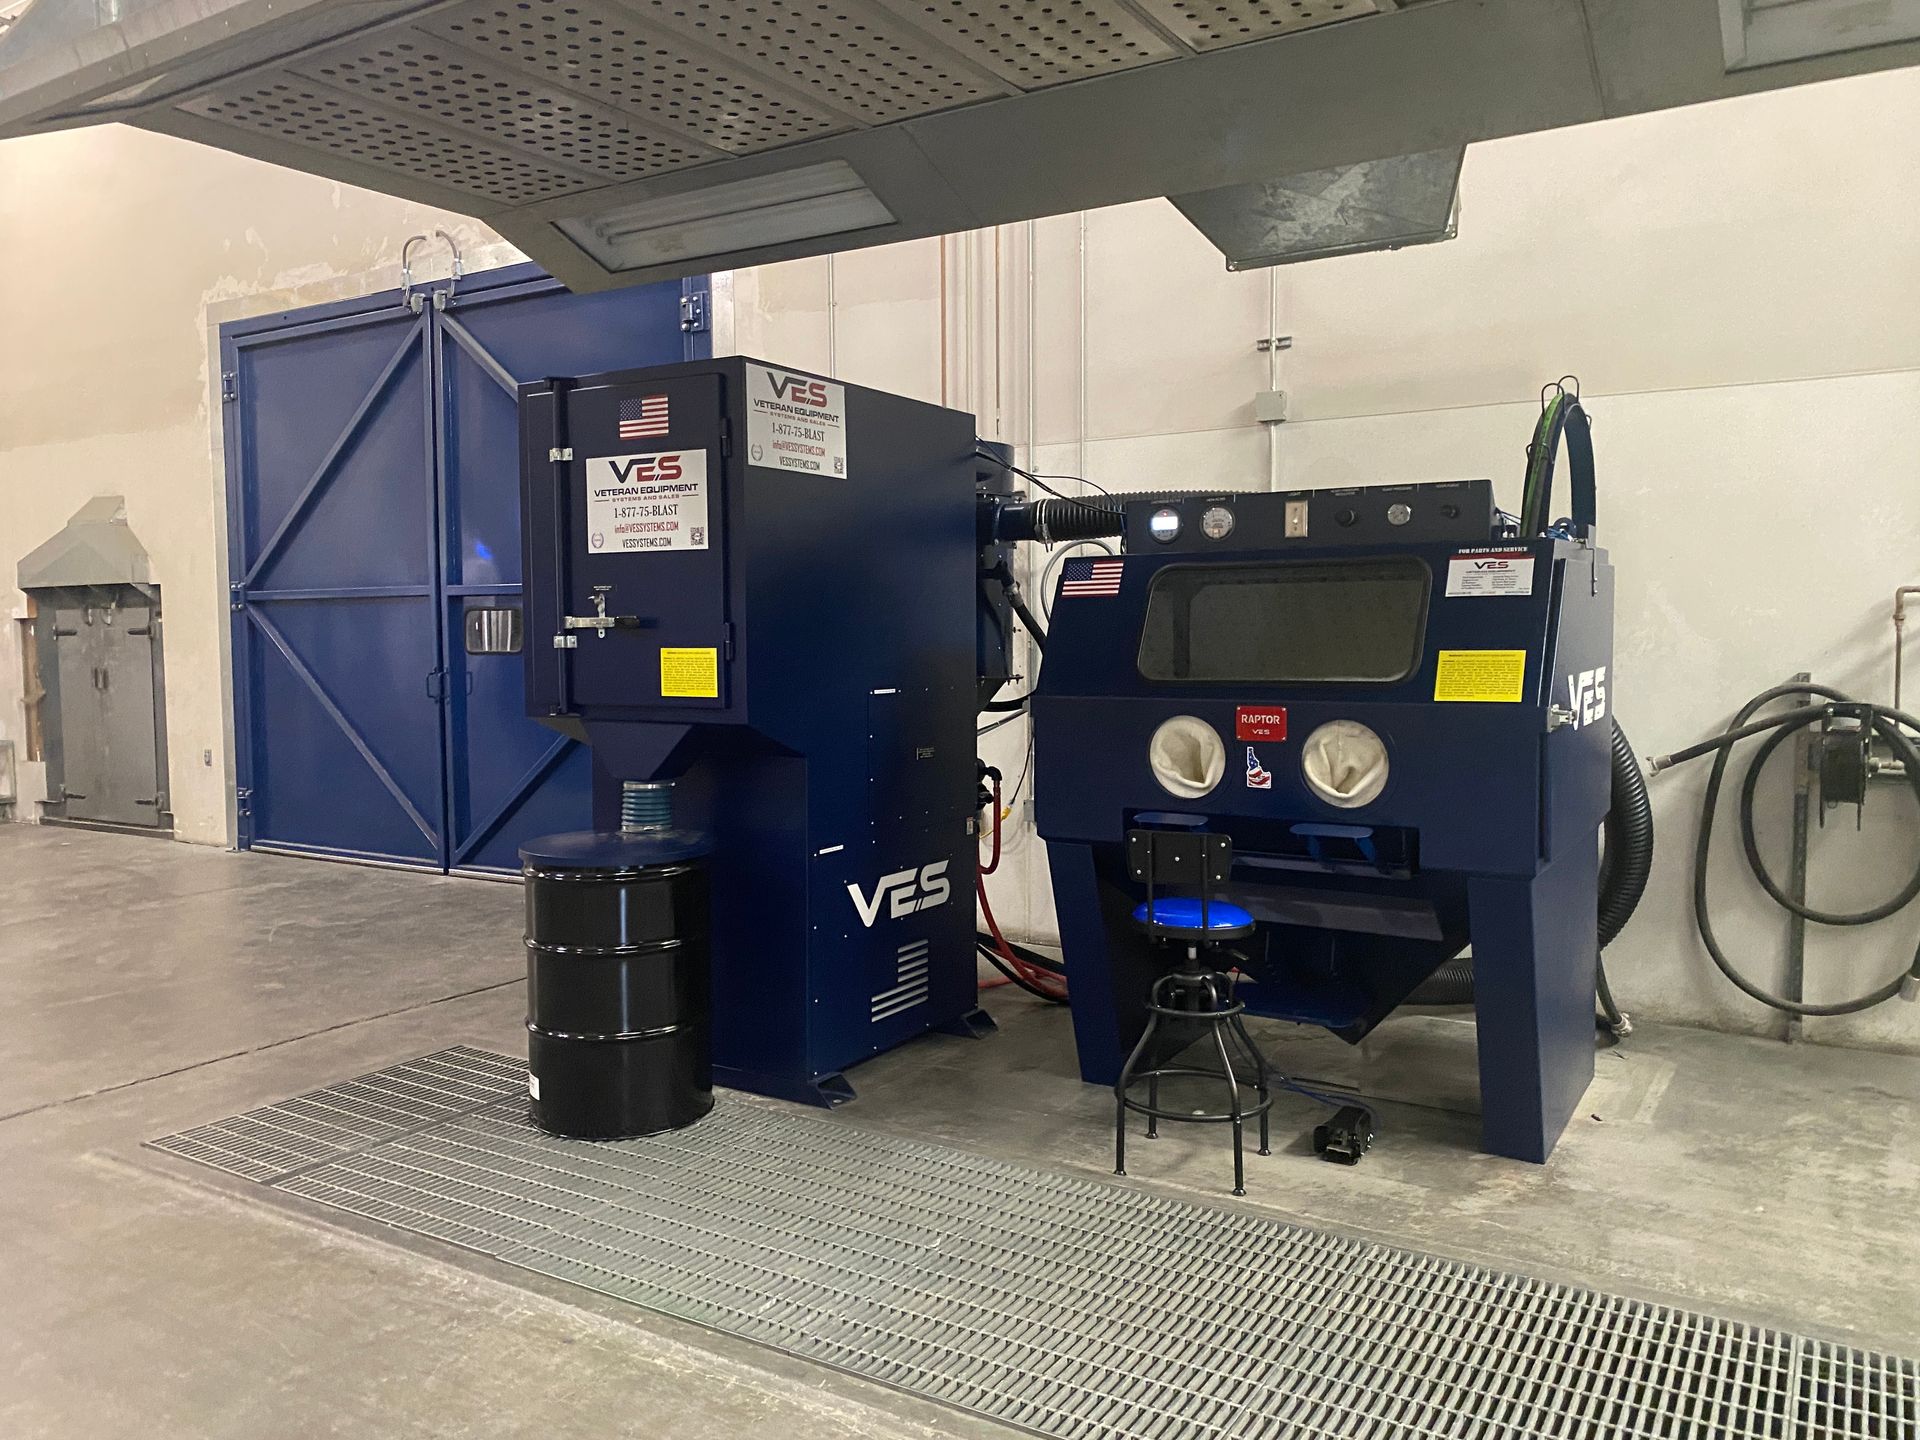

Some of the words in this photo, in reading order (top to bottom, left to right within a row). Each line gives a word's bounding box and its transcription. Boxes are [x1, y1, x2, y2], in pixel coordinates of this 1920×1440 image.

[767, 371, 827, 408] VES
[753, 398, 793, 413] VETERAN
[794, 407, 840, 423] EQUIPMENT
[772, 422, 825, 441] 1-877-75-BLAST
[609, 455, 683, 484] VES
[594, 487, 639, 497] VETERAN
[640, 483, 699, 494] EQUIPMENT
[614, 504, 679, 518] 1-877-75-BLAST
[622, 537, 672, 548] VESSYSTEMS.COM
[1474, 561, 1509, 570] VES
[1568, 666, 1606, 731] VES
[1241, 714, 1281, 724] RAPTOR
[847, 859, 951, 928] VES
